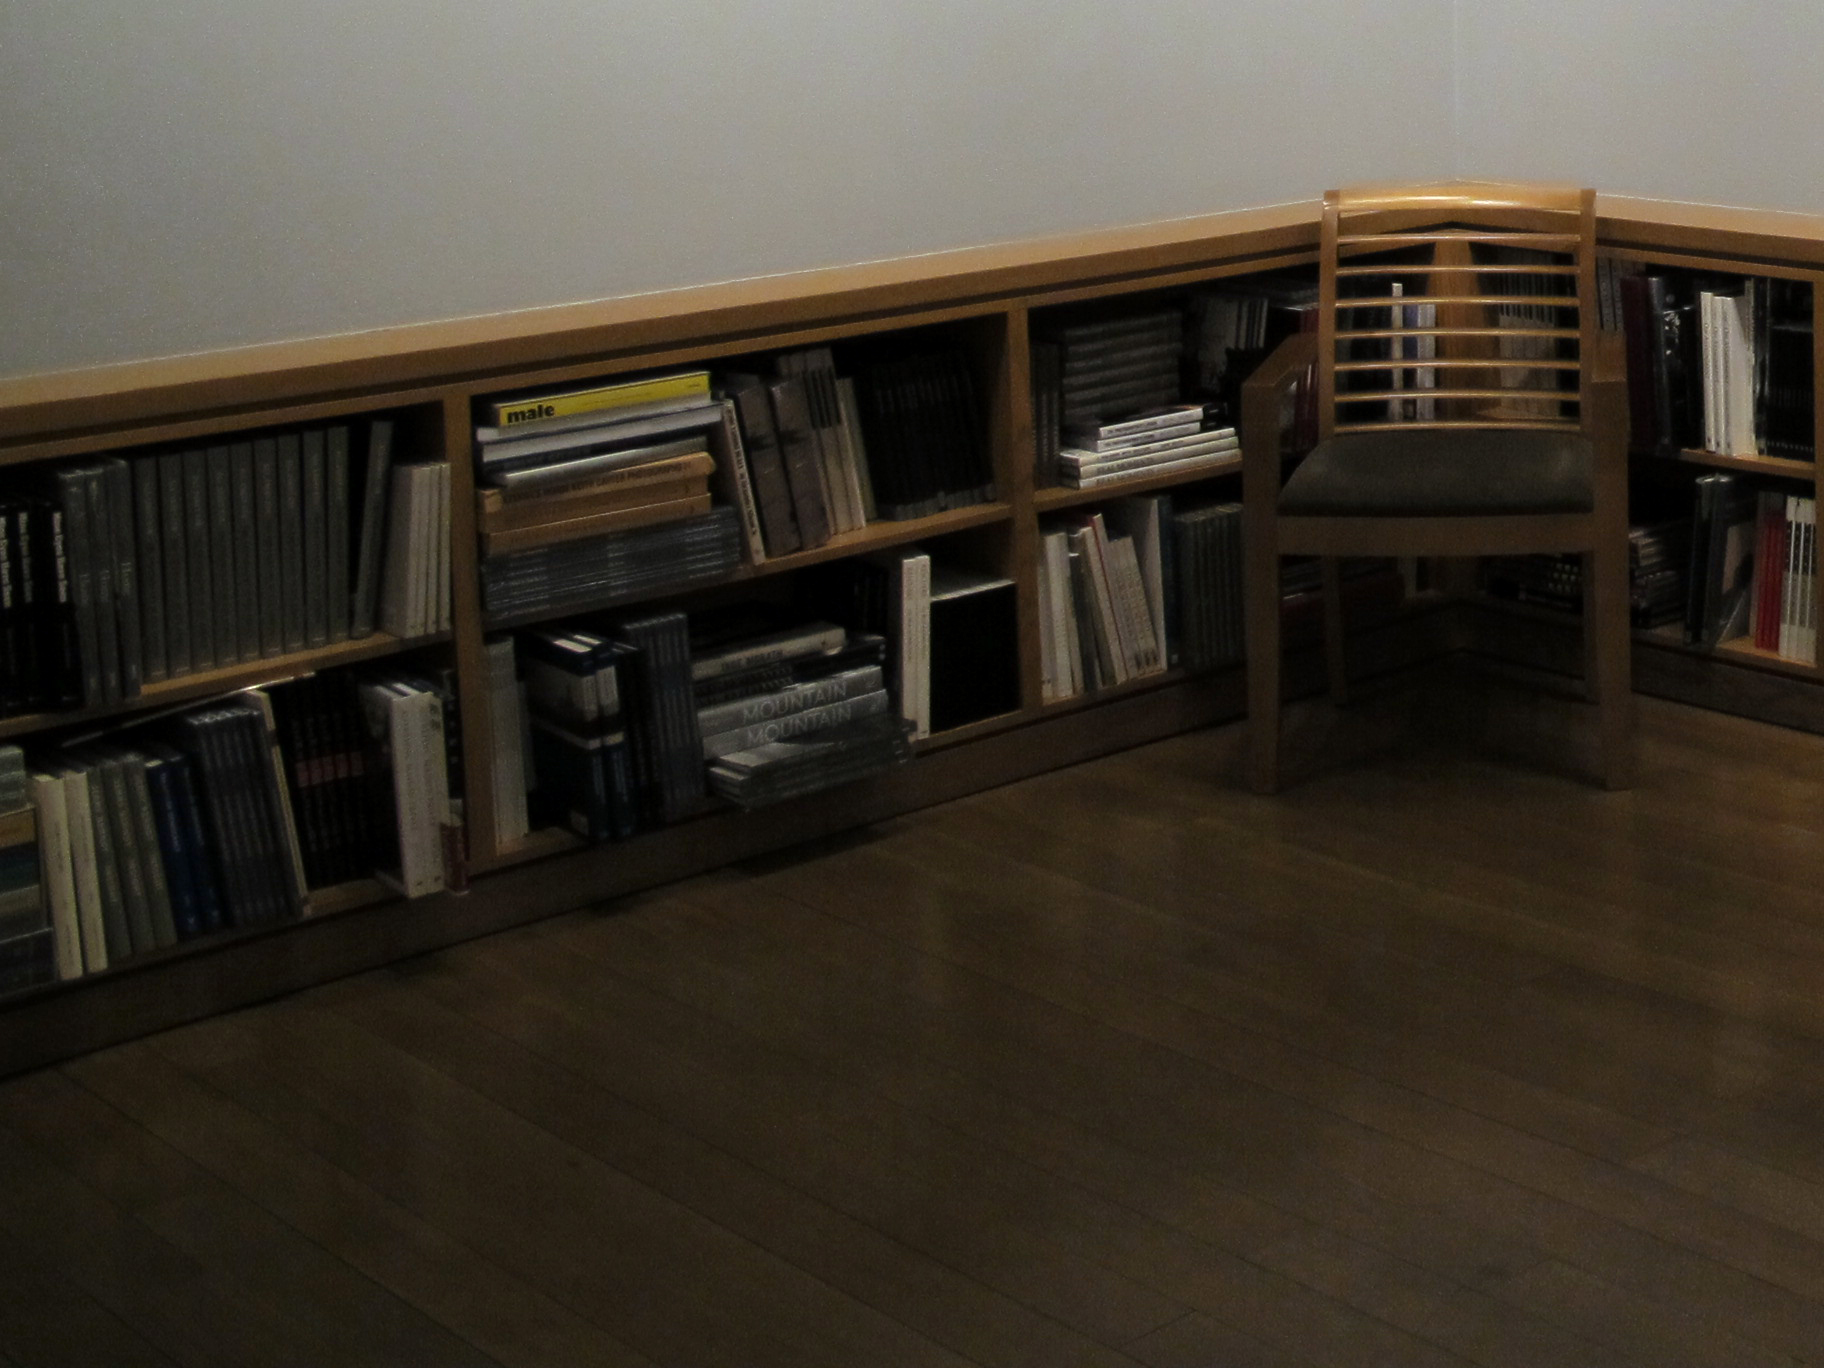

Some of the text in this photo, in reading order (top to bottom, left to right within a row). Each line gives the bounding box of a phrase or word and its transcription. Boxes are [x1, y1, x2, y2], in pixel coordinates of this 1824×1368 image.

[507, 403, 555, 424] male
[742, 682, 848, 724] MOUNTAIN
[747, 705, 852, 745] MOUNTAIN
